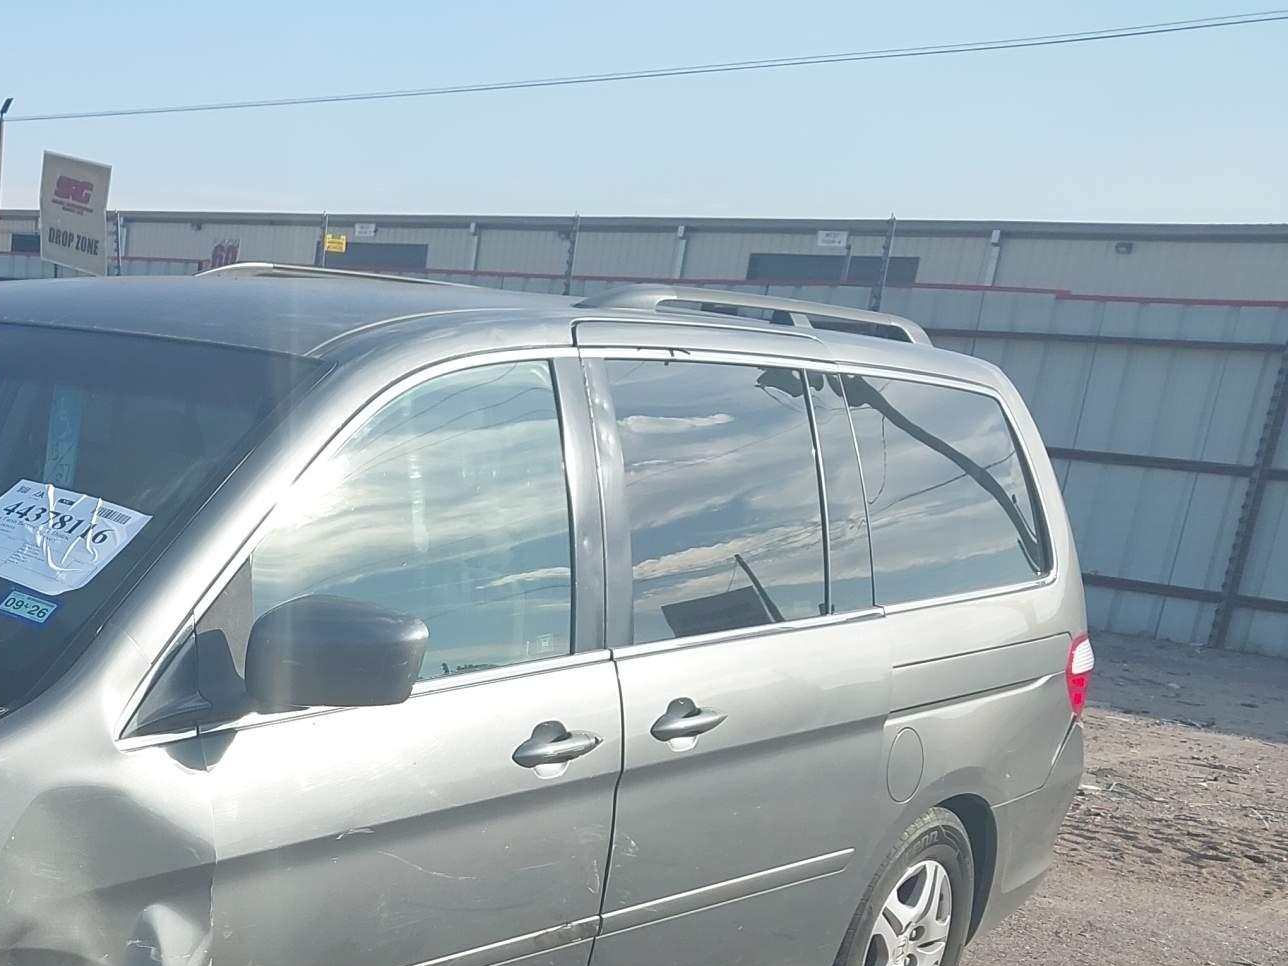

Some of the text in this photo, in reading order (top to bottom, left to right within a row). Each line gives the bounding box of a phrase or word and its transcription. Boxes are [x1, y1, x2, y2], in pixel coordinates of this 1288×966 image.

[48, 227, 100, 256] DROP ZONE
[4, 597, 49, 618] 09 26
